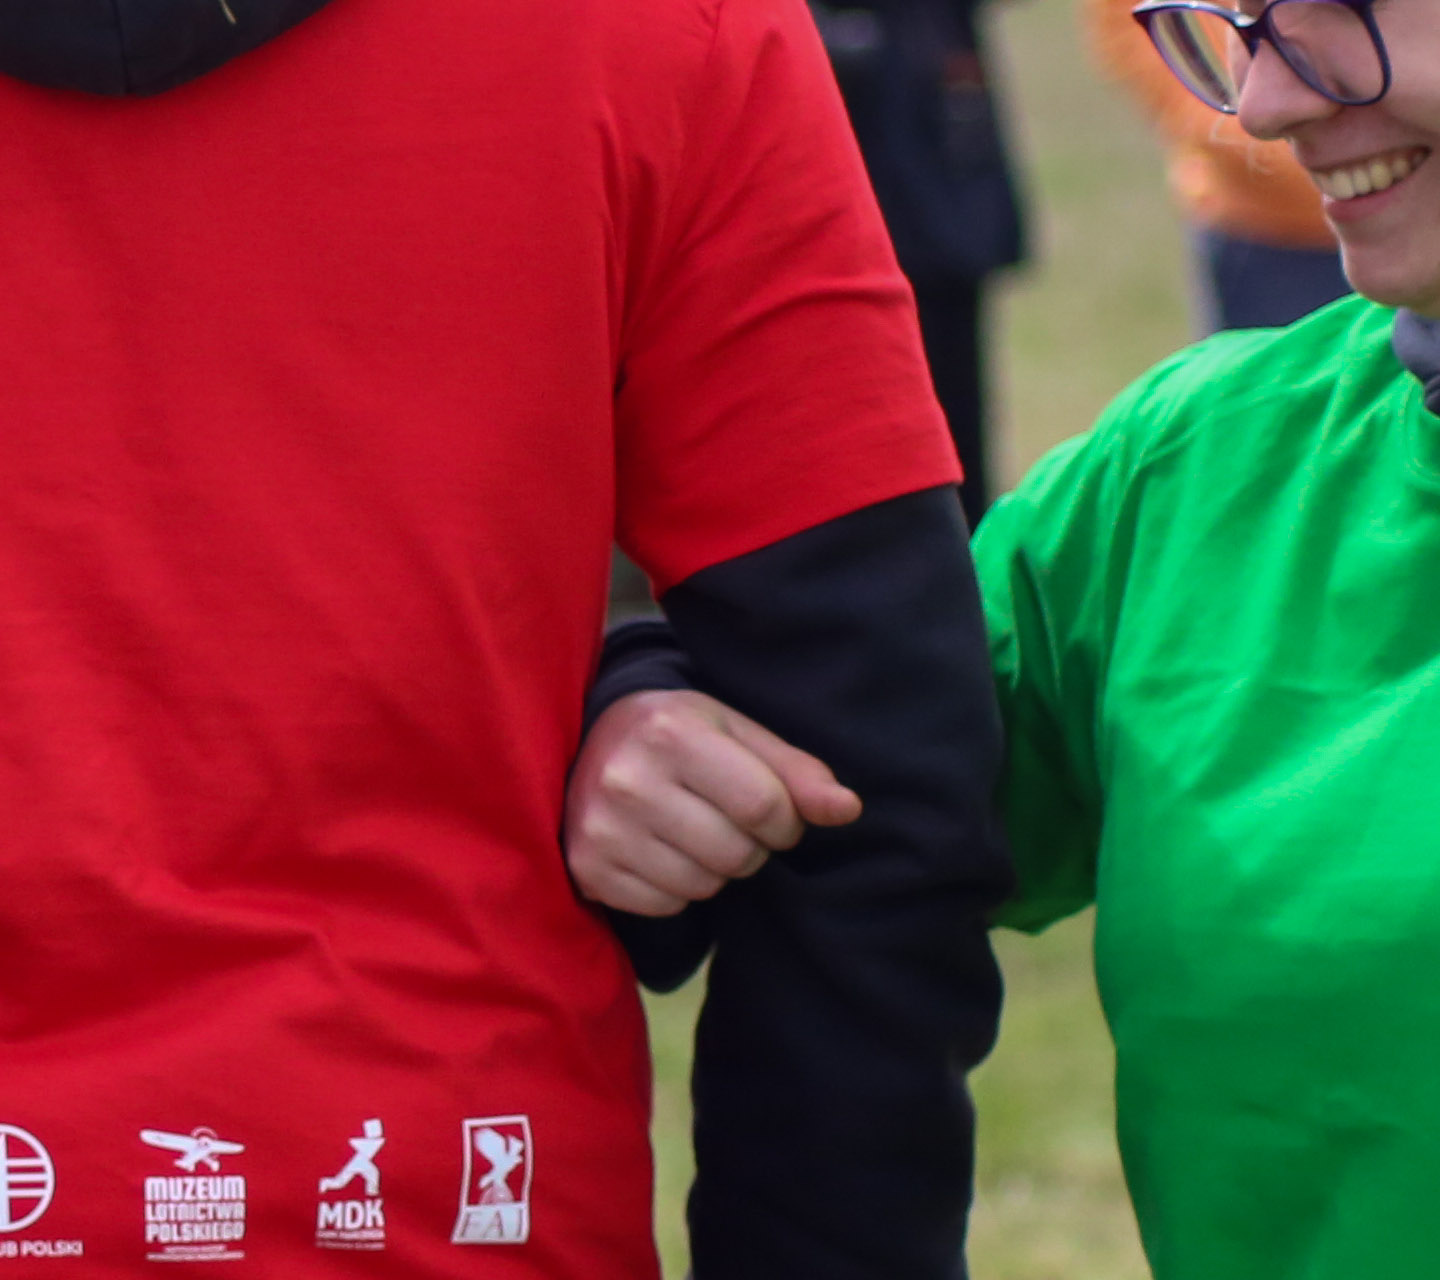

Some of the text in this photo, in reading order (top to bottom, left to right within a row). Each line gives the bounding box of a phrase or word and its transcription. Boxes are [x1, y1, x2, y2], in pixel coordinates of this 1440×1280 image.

[145, 1175, 246, 1201] MUZEUM
[318, 1198, 386, 1229] MDK
[21, 1239, 84, 1258] POLSKI
